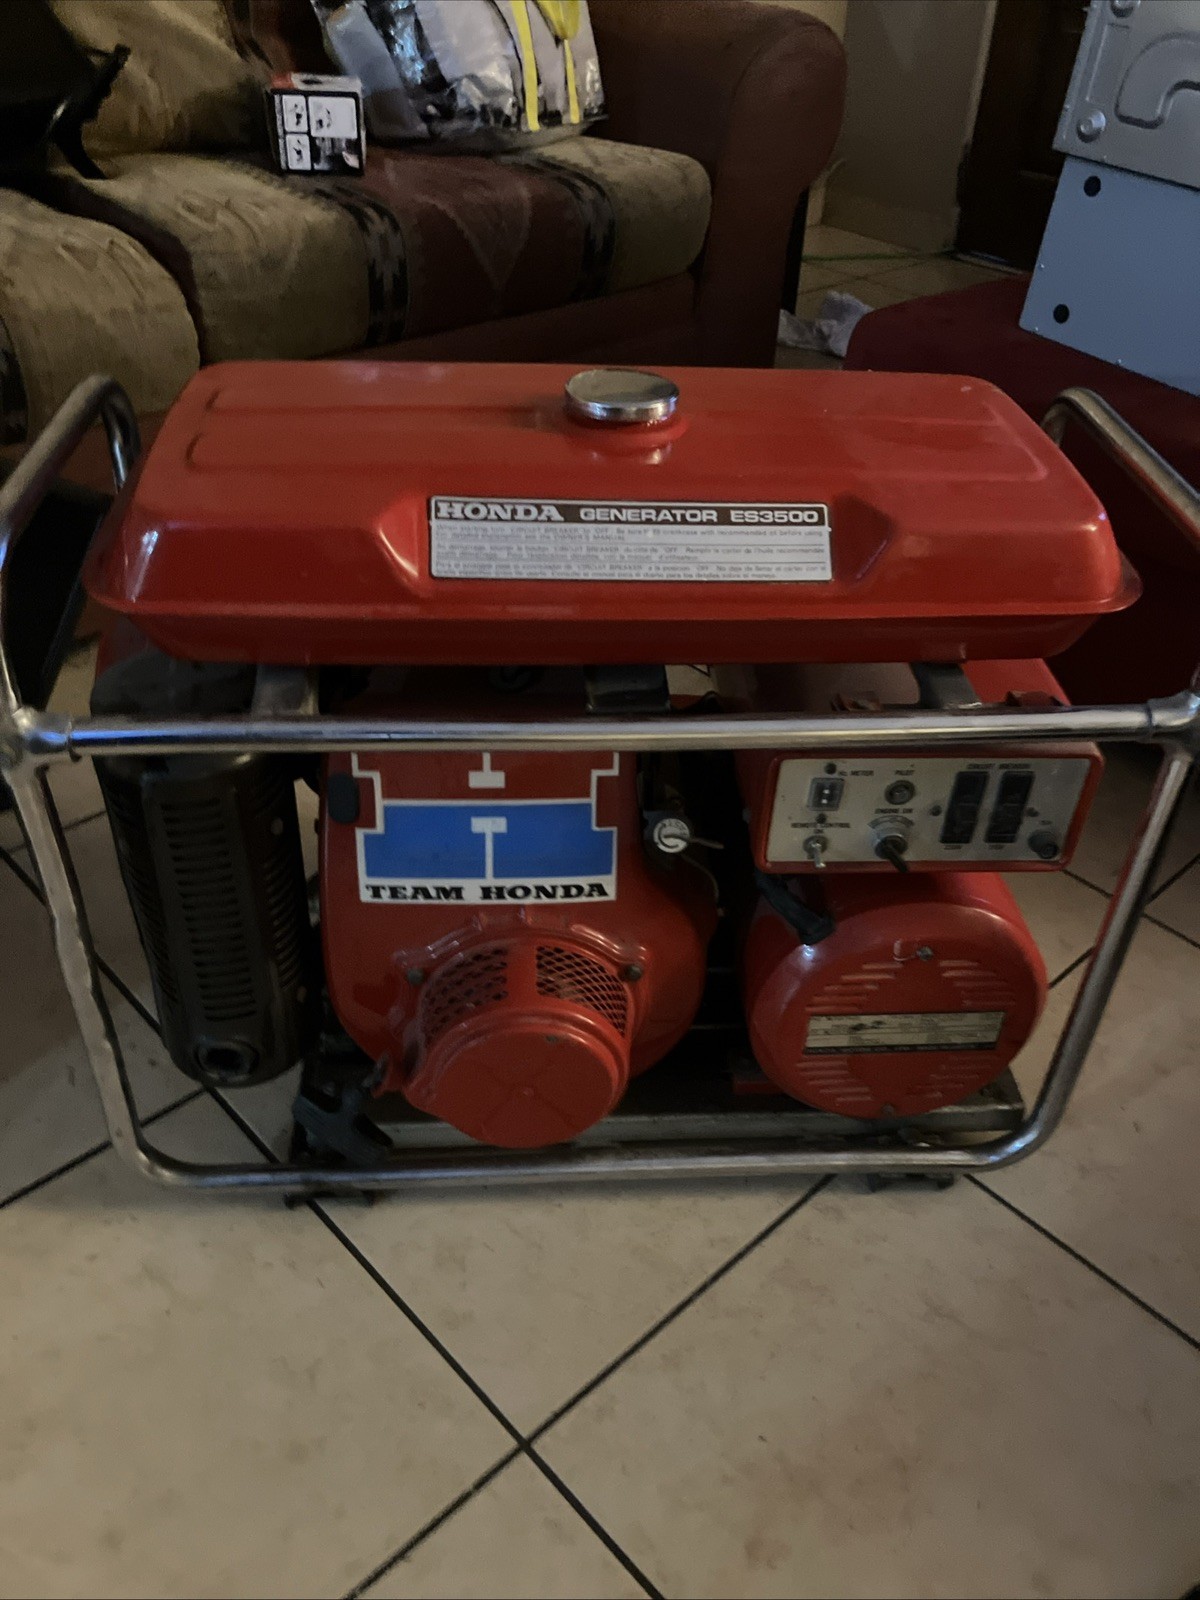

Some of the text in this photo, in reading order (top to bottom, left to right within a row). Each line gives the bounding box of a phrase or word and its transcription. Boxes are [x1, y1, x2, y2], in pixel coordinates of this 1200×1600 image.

[437, 502, 819, 523] HONDA GENERATOR ES3500
[365, 883, 608, 900] TEAM HONDA
